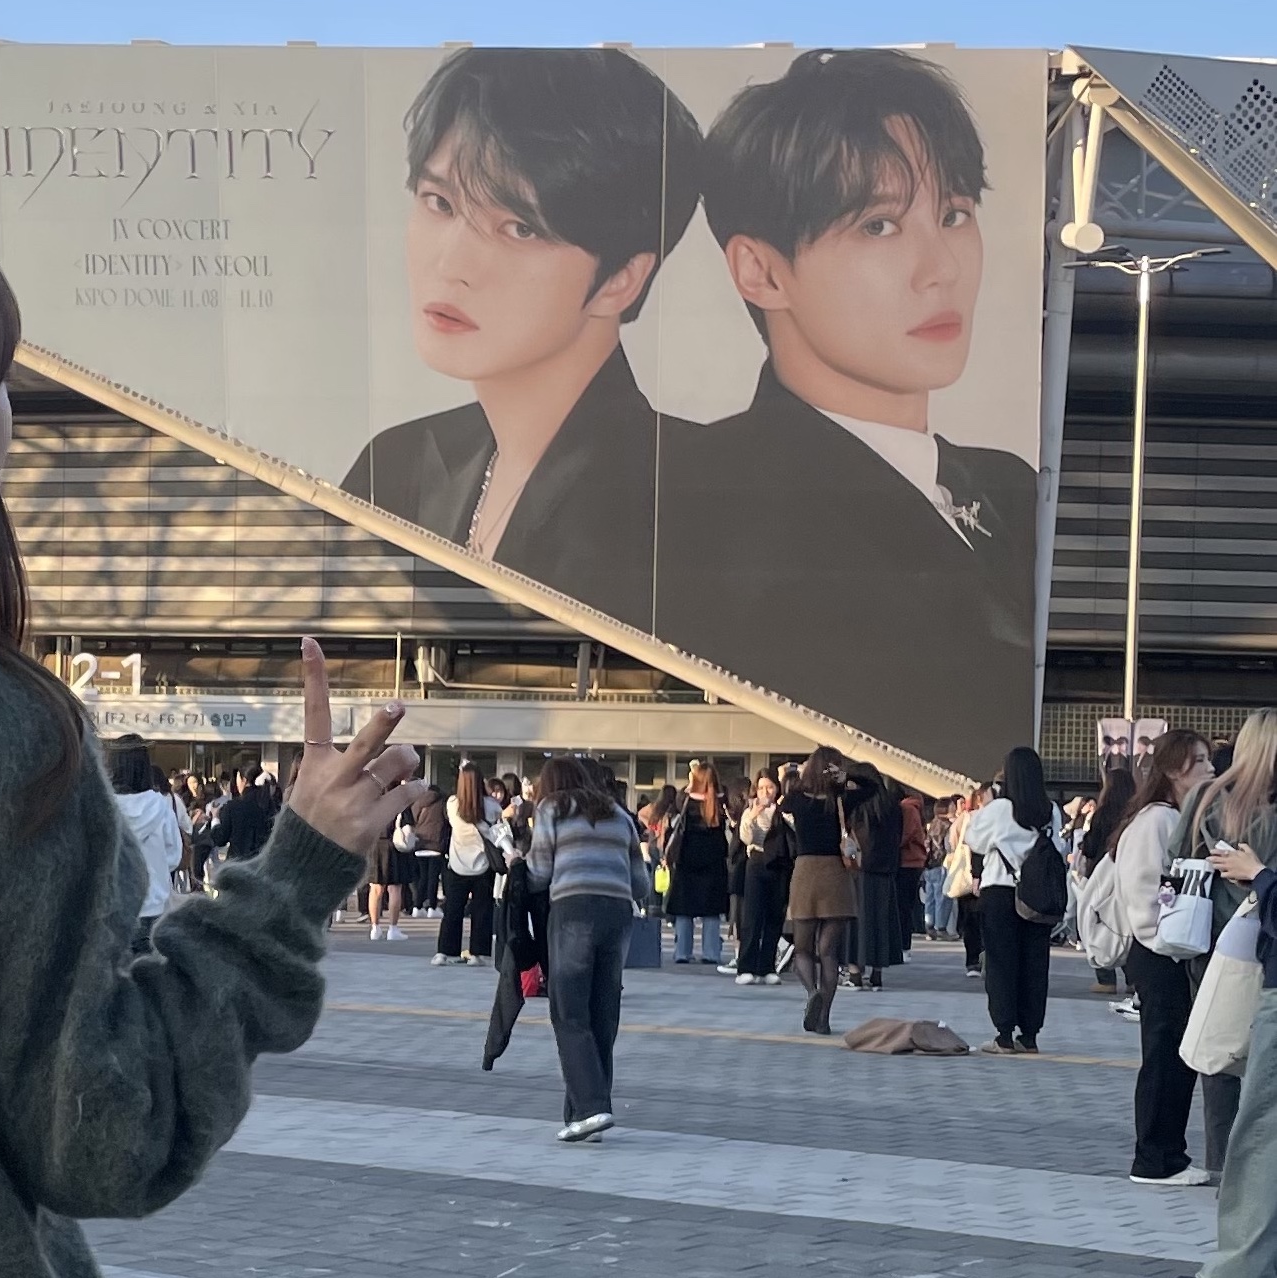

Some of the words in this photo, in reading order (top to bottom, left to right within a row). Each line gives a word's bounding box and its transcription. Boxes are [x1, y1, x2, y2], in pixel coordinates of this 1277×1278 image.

[233, 100, 279, 117] XIA
[1, 99, 336, 210] IDENTITY
[137, 218, 231, 241] CONCERT
[191, 254, 209, 277] IN
[213, 254, 274, 278] SEOUL
[74, 286, 118, 307] KSPO
[123, 287, 175, 308] DOME
[182, 288, 220, 309] 11.08
[70, 652, 142, 697] 2-1
[210, 713, 247, 727] 출입구
